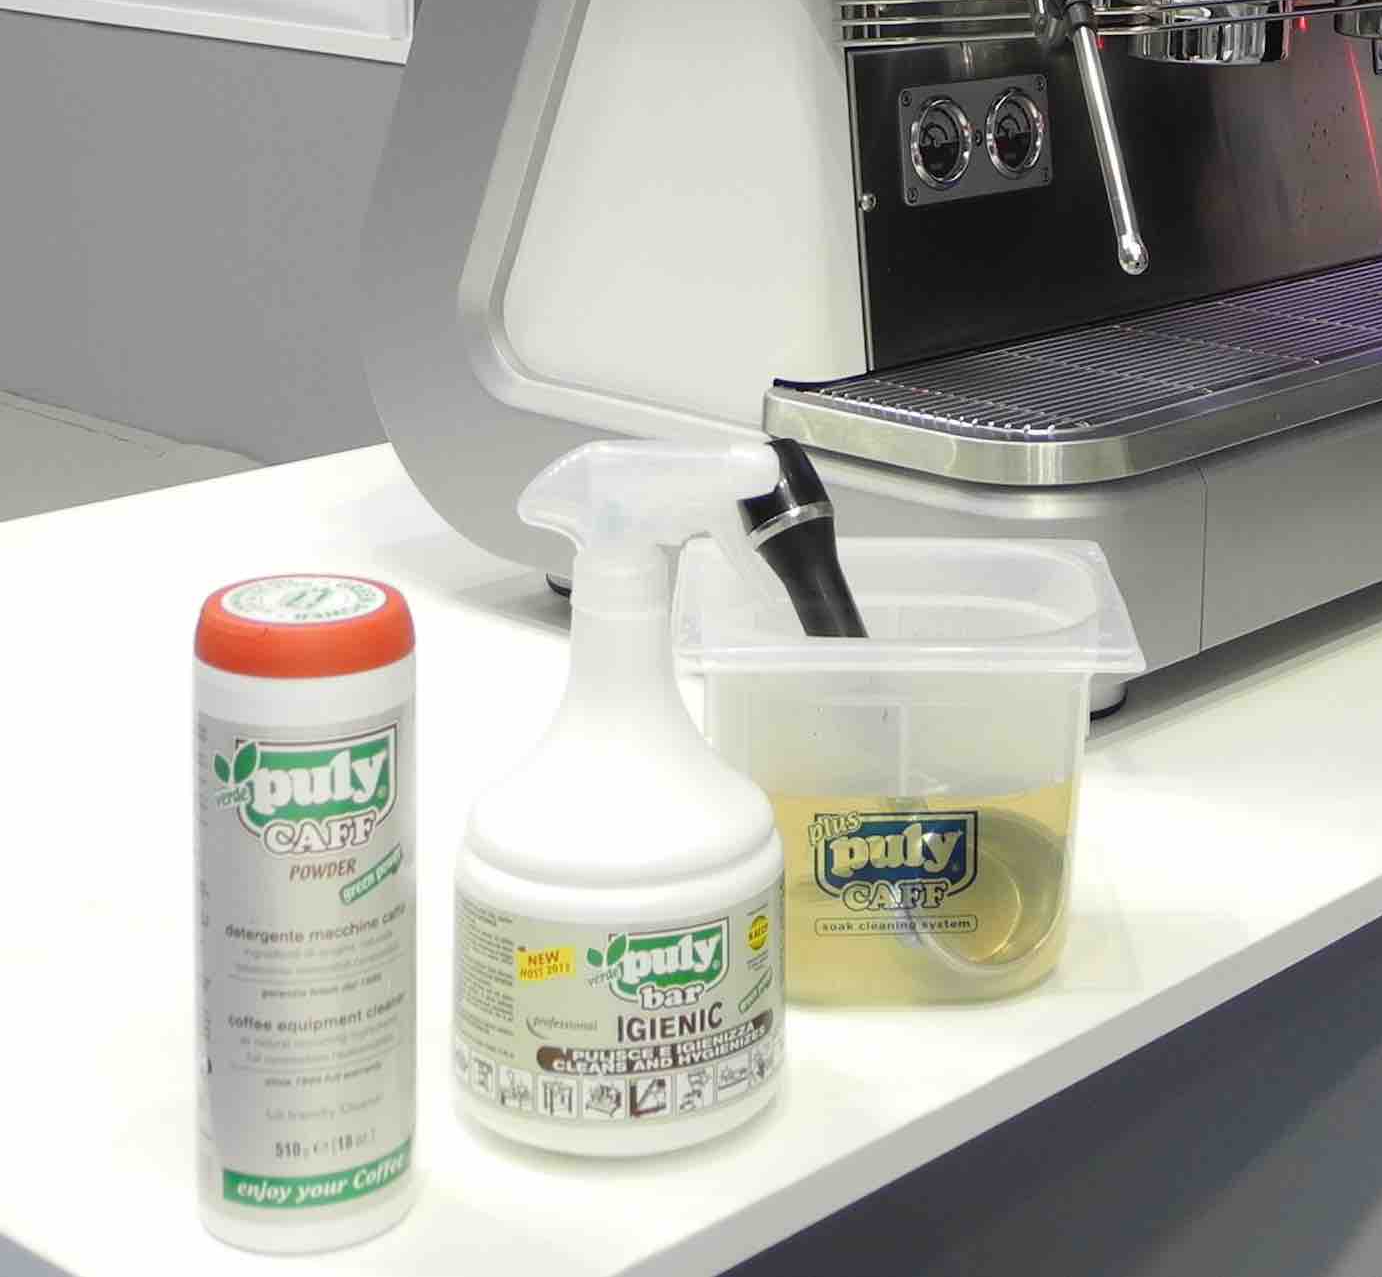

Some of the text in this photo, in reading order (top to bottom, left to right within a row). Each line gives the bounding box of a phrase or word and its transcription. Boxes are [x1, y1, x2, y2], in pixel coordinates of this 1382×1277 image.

[250, 747, 389, 816] puly
[263, 810, 378, 857] CAFF
[808, 812, 858, 846] plus
[829, 823, 963, 878] puly
[289, 857, 357, 882] POWDER
[842, 879, 949, 912] CAFF
[225, 924, 304, 944] detergente
[309, 917, 378, 942] macchine
[822, 917, 972, 932] soak cleaning system
[527, 951, 560, 966] NEW
[620, 925, 721, 985] puly
[641, 984, 705, 1011] bar
[227, 1014, 272, 1032] coffee
[277, 1010, 362, 1036] equipment
[617, 1002, 723, 1044] IGIENIC
[553, 1058, 626, 1074] CLEANS
[633, 1058, 673, 1073] AND
[237, 1180, 290, 1203] enjoy
[295, 1179, 348, 1202] your
